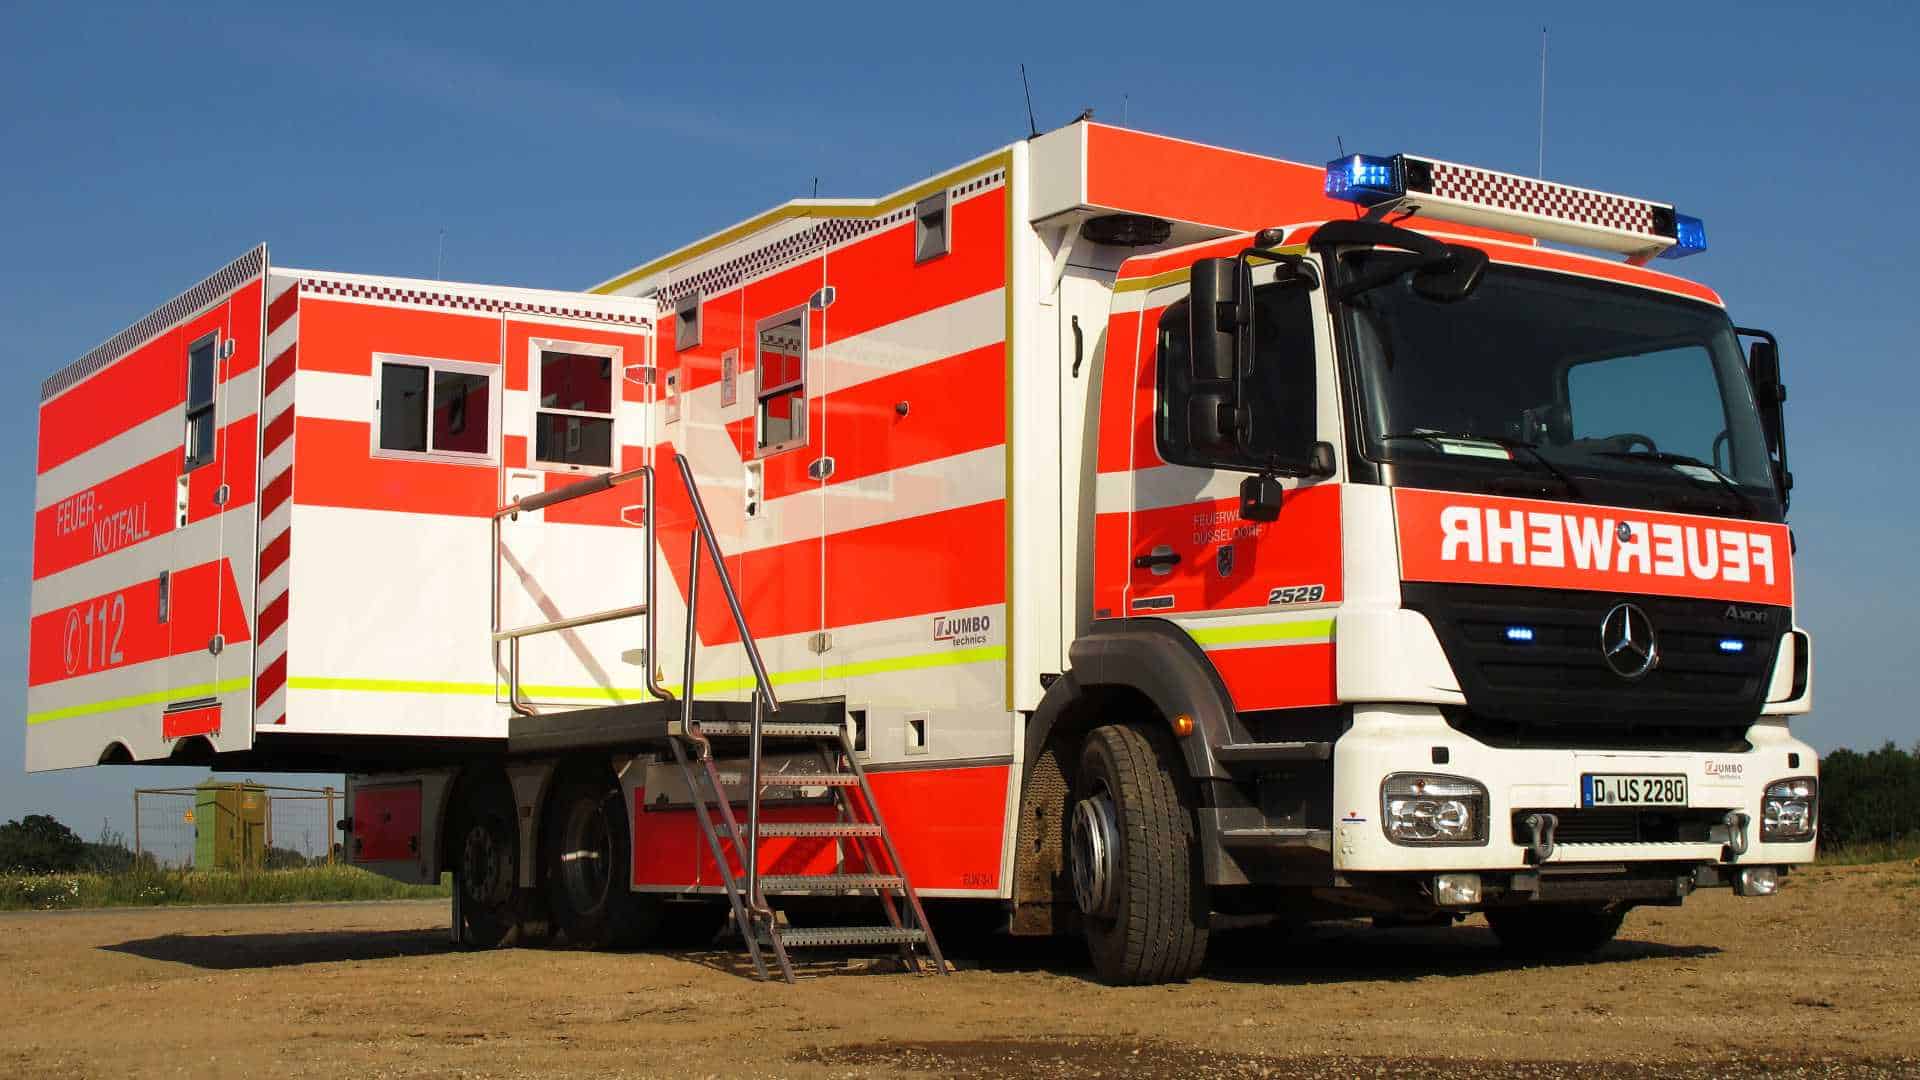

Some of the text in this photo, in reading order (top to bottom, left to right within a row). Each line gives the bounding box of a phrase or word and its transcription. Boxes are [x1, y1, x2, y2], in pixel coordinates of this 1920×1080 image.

[93, 500, 150, 558] NOTFALL
[1269, 586, 1323, 604] 2529
[85, 593, 126, 673] 112
[944, 615, 991, 636] JUMBO
[952, 634, 987, 647] technics
[1712, 763, 1743, 774] JUMBO
[1643, 779, 1684, 802] 2280
